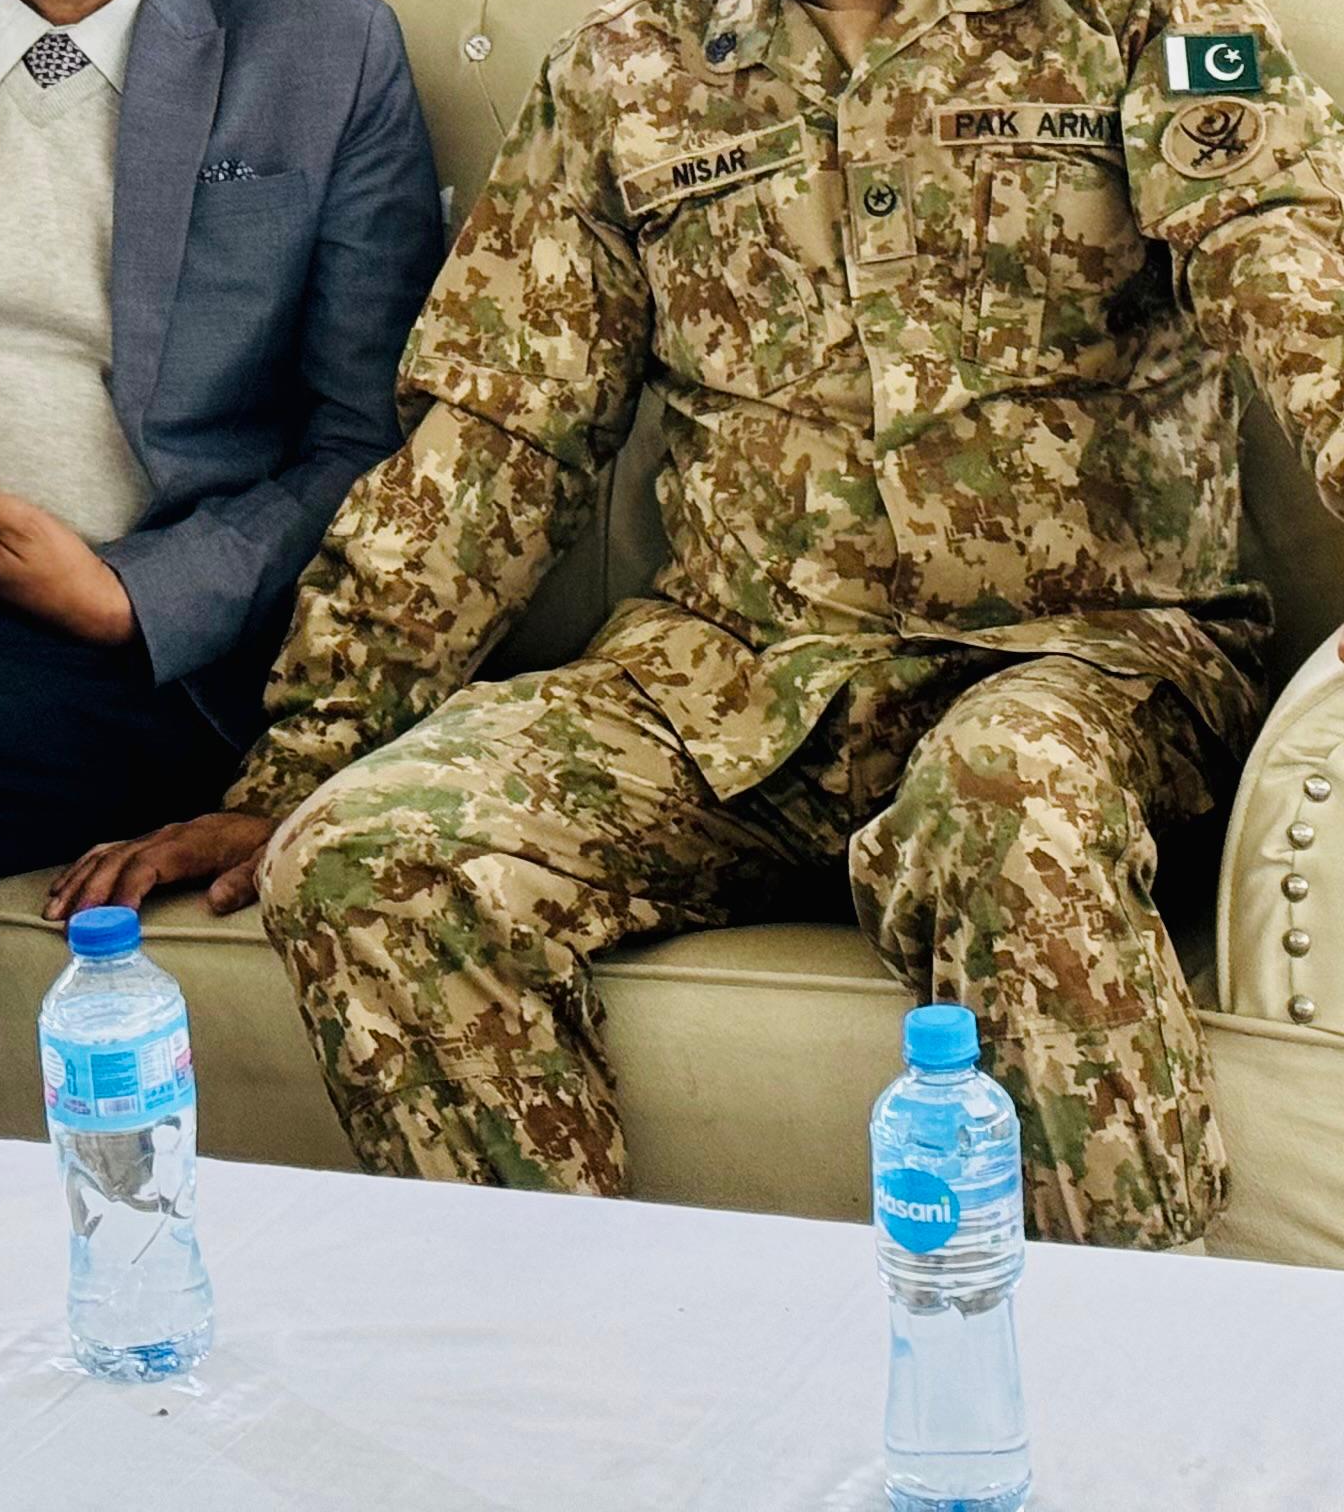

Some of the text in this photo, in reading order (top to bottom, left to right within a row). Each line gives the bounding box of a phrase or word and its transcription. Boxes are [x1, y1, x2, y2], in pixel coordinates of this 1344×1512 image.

[956, 110, 1121, 139] PAK ARMY
[672, 145, 747, 188] NISAR
